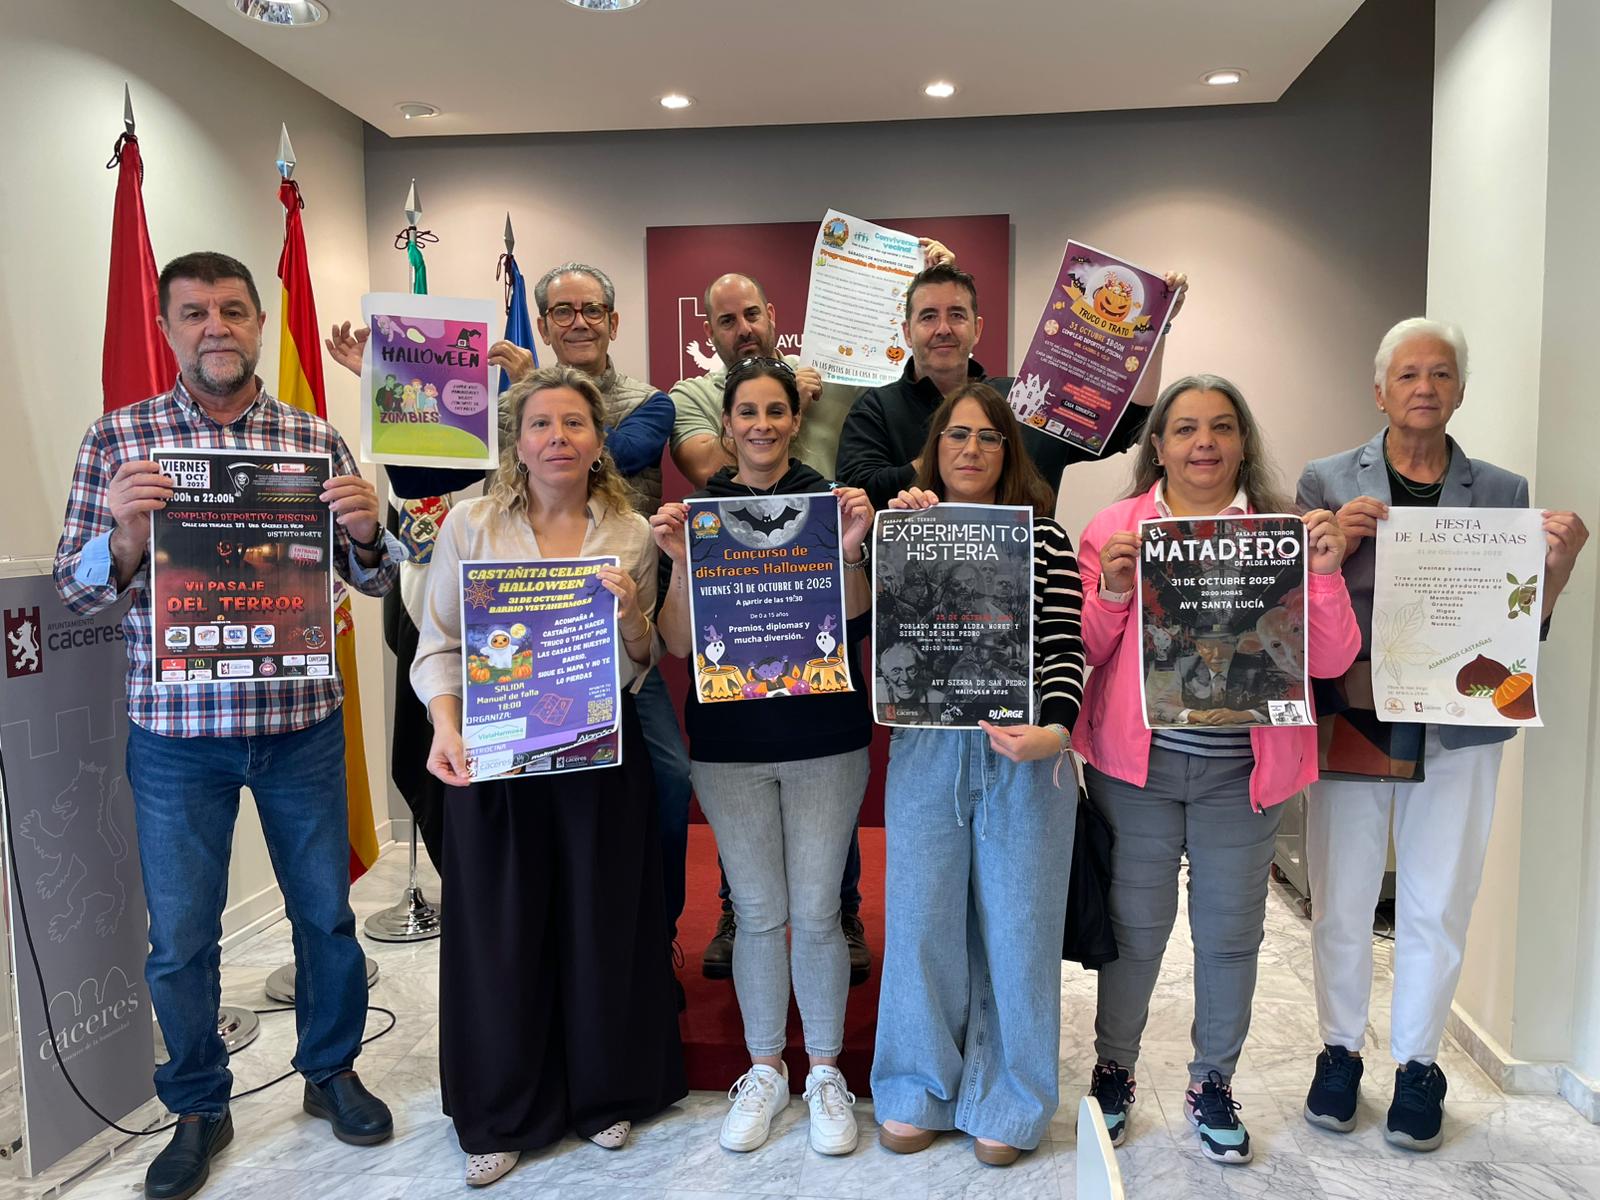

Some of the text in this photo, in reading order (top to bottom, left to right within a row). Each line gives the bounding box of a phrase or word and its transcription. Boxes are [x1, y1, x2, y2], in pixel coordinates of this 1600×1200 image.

[1078, 307, 1130, 337] TRUCO O TRATO
[1070, 322, 1106, 343] 31 OCTUBRE
[382, 346, 479, 368] HALLOWEEN
[380, 412, 440, 424] ZOMBIES
[161, 461, 207, 473] VIERNES
[161, 492, 192, 502] :00h
[203, 493, 235, 503] 22:00h
[167, 512, 318, 522] COMPLEJO DEPORTIVO (PISCINA)
[1435, 519, 1482, 530] FIESTA
[882, 524, 1029, 543] EXPERIMENTO
[1149, 527, 1168, 541] EL
[1395, 532, 1527, 545] DE LAS CASTAÑAS
[723, 545, 808, 561] Concurso de
[907, 544, 999, 561] HISTERIA
[1145, 537, 1300, 563] MATADERO
[468, 564, 609, 580] CASTAÑITA CELEBR
[696, 562, 833, 579] disfraces Halloween
[184, 580, 265, 592] VII PASAJE
[498, 579, 586, 593] HALLOWEEN
[700, 577, 832, 596] VIERNES 31 DE OCTUBRE DE 2025
[1171, 576, 1276, 587] 31 DE OCTUBRE 2025
[167, 596, 305, 613] DEL TERROR
[508, 593, 576, 605] 31 DE OCTUBRE
[743, 598, 763, 607] partir
[1180, 599, 1265, 610] AVV SANTA LUCÍA
[489, 598, 593, 614] BARRIO VISTAHERMOSA
[48, 618, 95, 631] AYUNTAMIENTO
[554, 613, 588, 626] ACOMPAÑA
[542, 626, 577, 638] CASTAÑITA
[585, 619, 605, 630] HACER
[595, 628, 608, 637] POR
[728, 622, 810, 634] Premios, diplomas y
[734, 632, 804, 645] mucha diversión.
[537, 637, 611, 659] LAS CASAS DE NUESTRO
[1428, 651, 1461, 670] ASAREMOS
[538, 669, 556, 679] SIGUE
[567, 664, 584, 673] MAPA
[592, 659, 601, 667] NO
[603, 657, 611, 665] TE
[566, 672, 593, 683] PIERDAS
[494, 682, 525, 694] SALIDA
[477, 690, 539, 705] Manuel de falla
[498, 701, 522, 711] 18:00
[466, 712, 512, 725] ORGANIZA:
